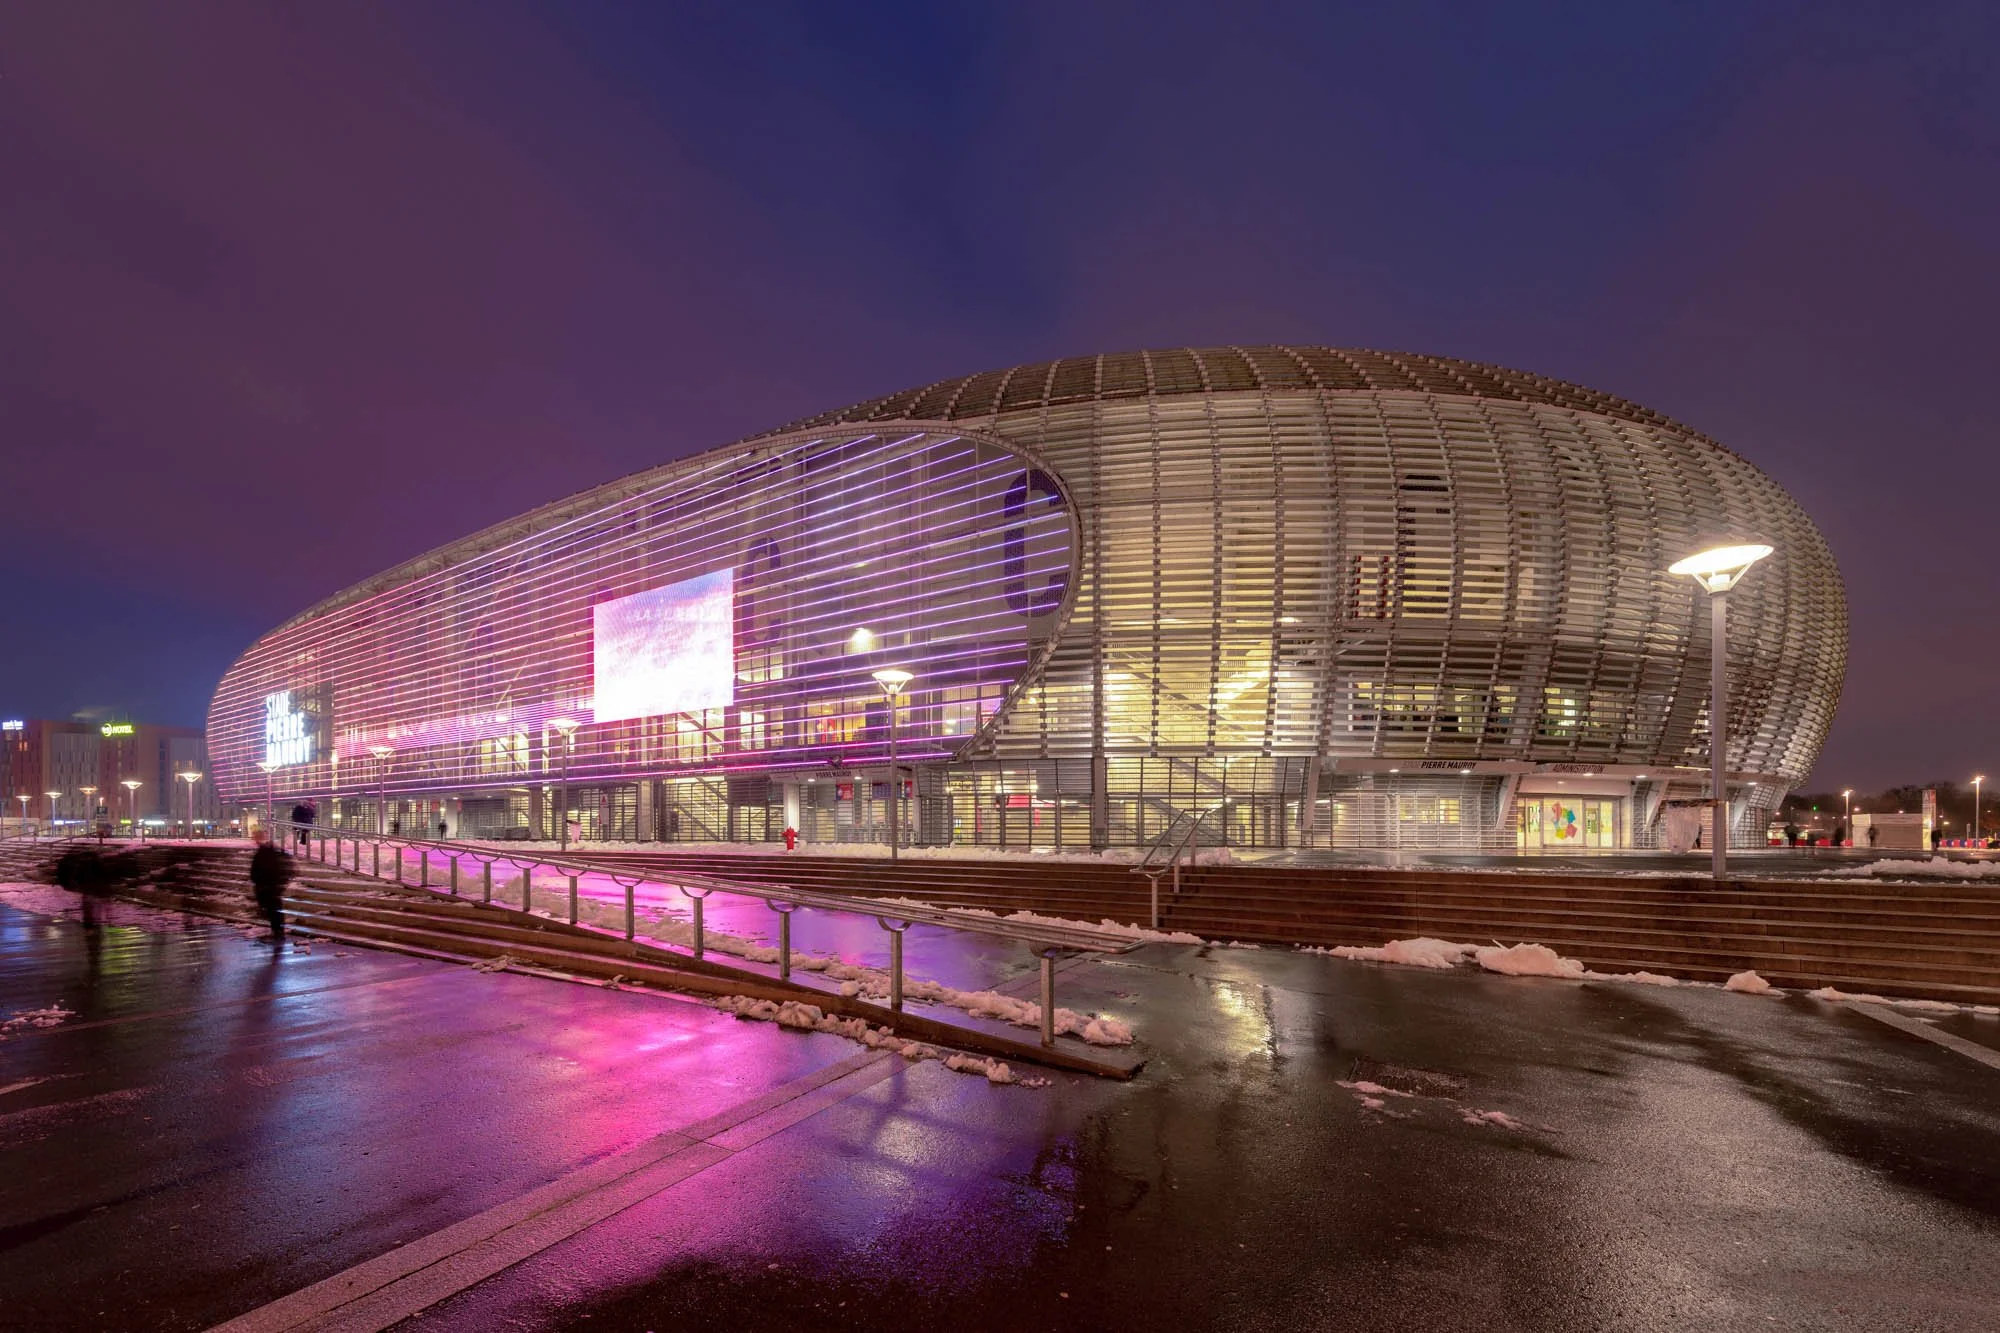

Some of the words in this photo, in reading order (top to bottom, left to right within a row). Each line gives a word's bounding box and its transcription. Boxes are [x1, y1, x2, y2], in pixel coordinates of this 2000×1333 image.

[266, 691, 290, 720] STADE
[266, 712, 305, 743] PIERRE
[266, 735, 311, 765] MAUROY
[1421, 761, 1446, 769] PIERRE
[1446, 761, 1477, 769] MAUROY
[1552, 763, 1605, 774] ADMINISTRATION
